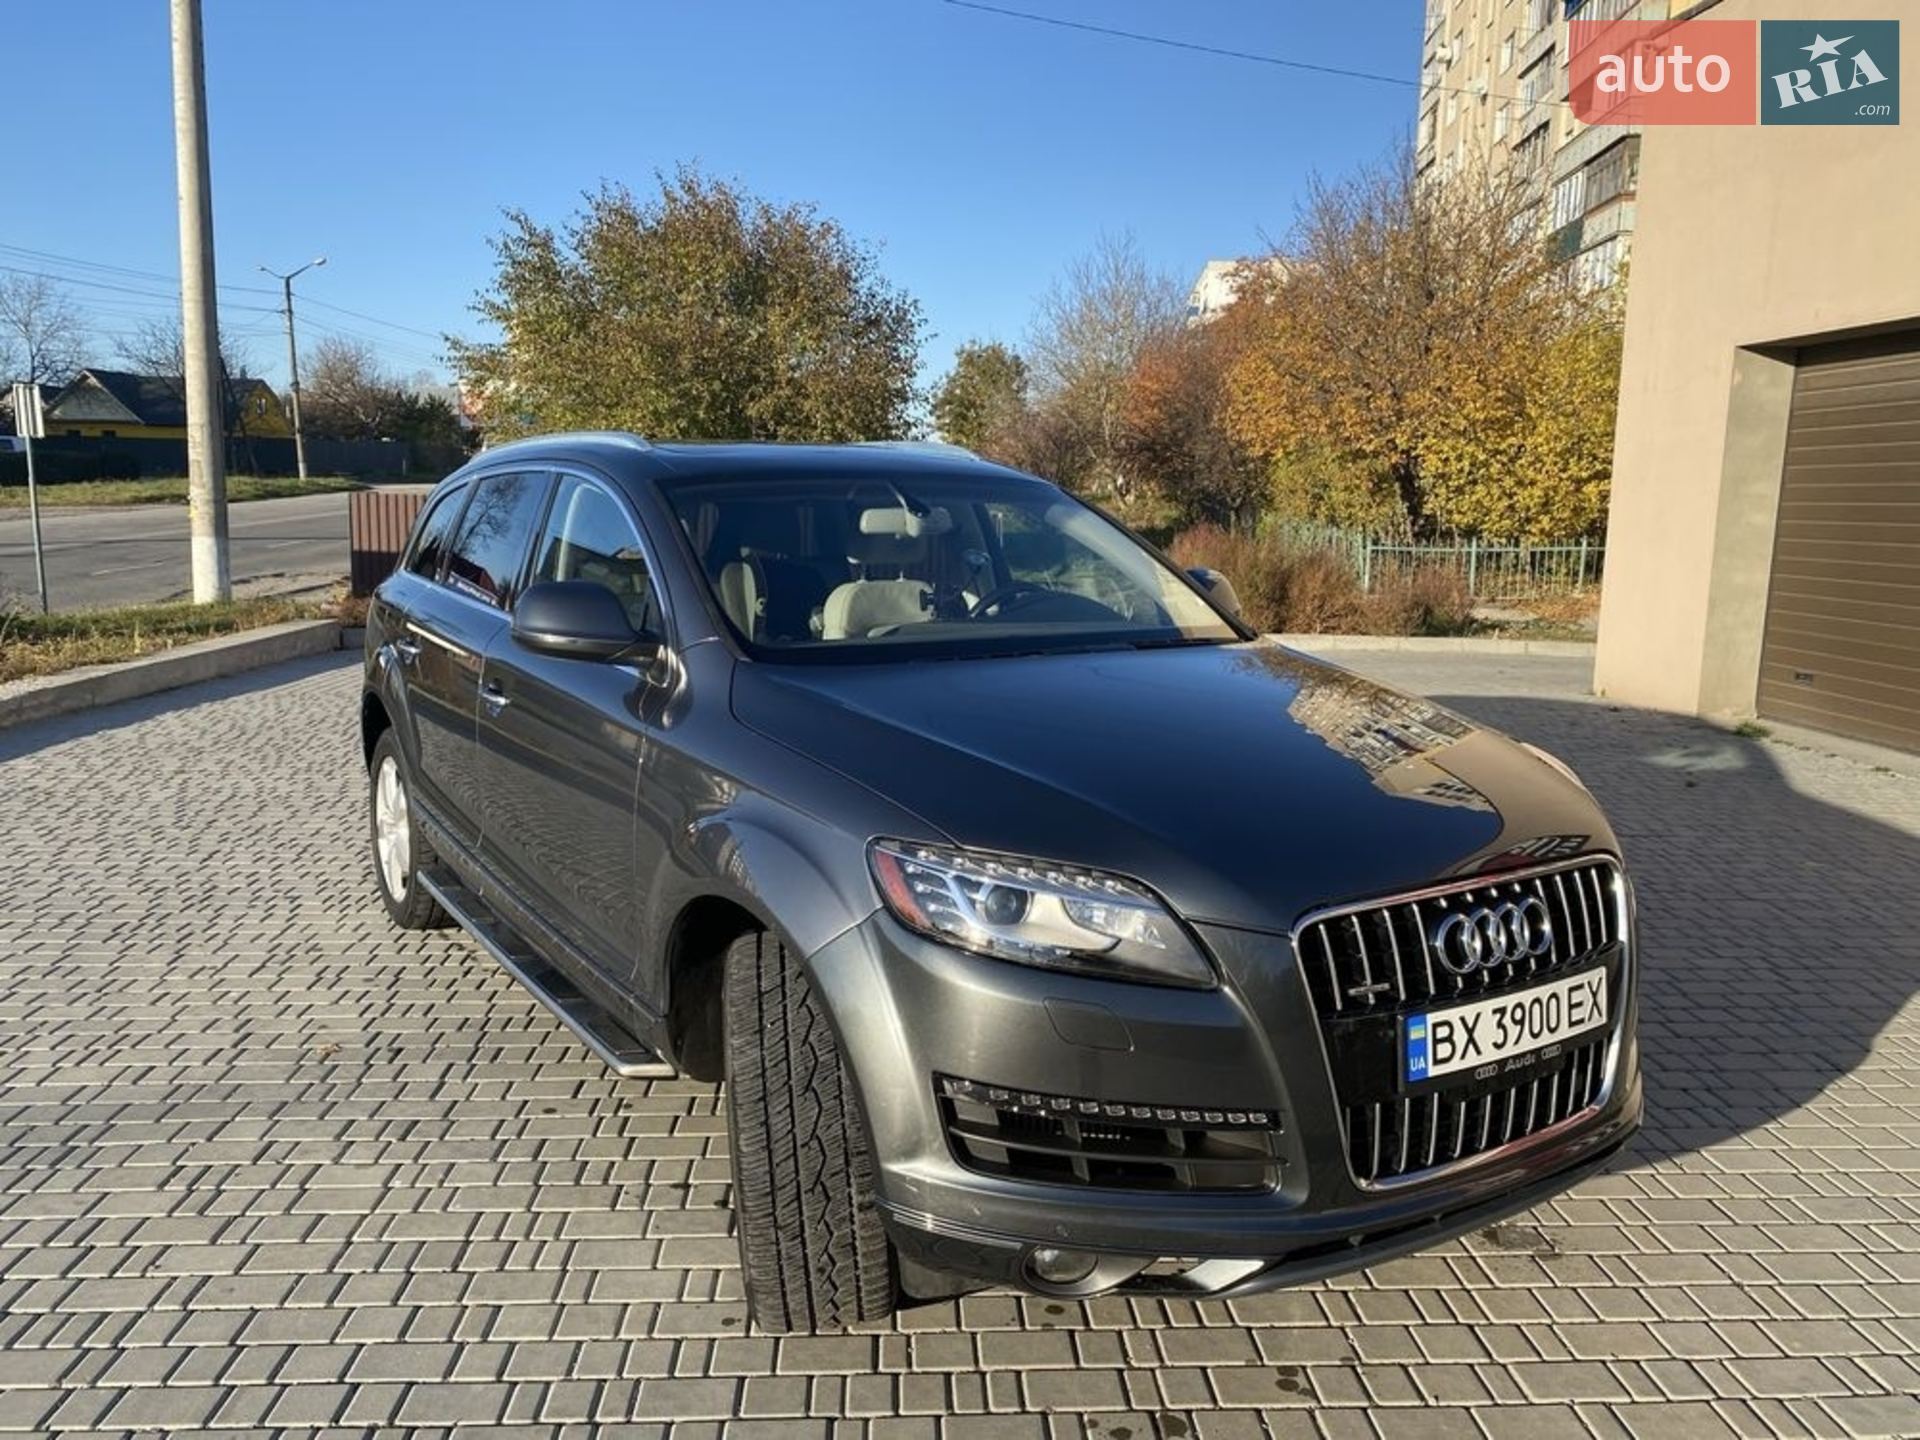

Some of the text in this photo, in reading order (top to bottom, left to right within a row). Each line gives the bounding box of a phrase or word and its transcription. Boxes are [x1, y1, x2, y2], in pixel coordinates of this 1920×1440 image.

[1432, 976, 1603, 1066] BX 3900 EX
[1410, 1056, 1426, 1071] UA
